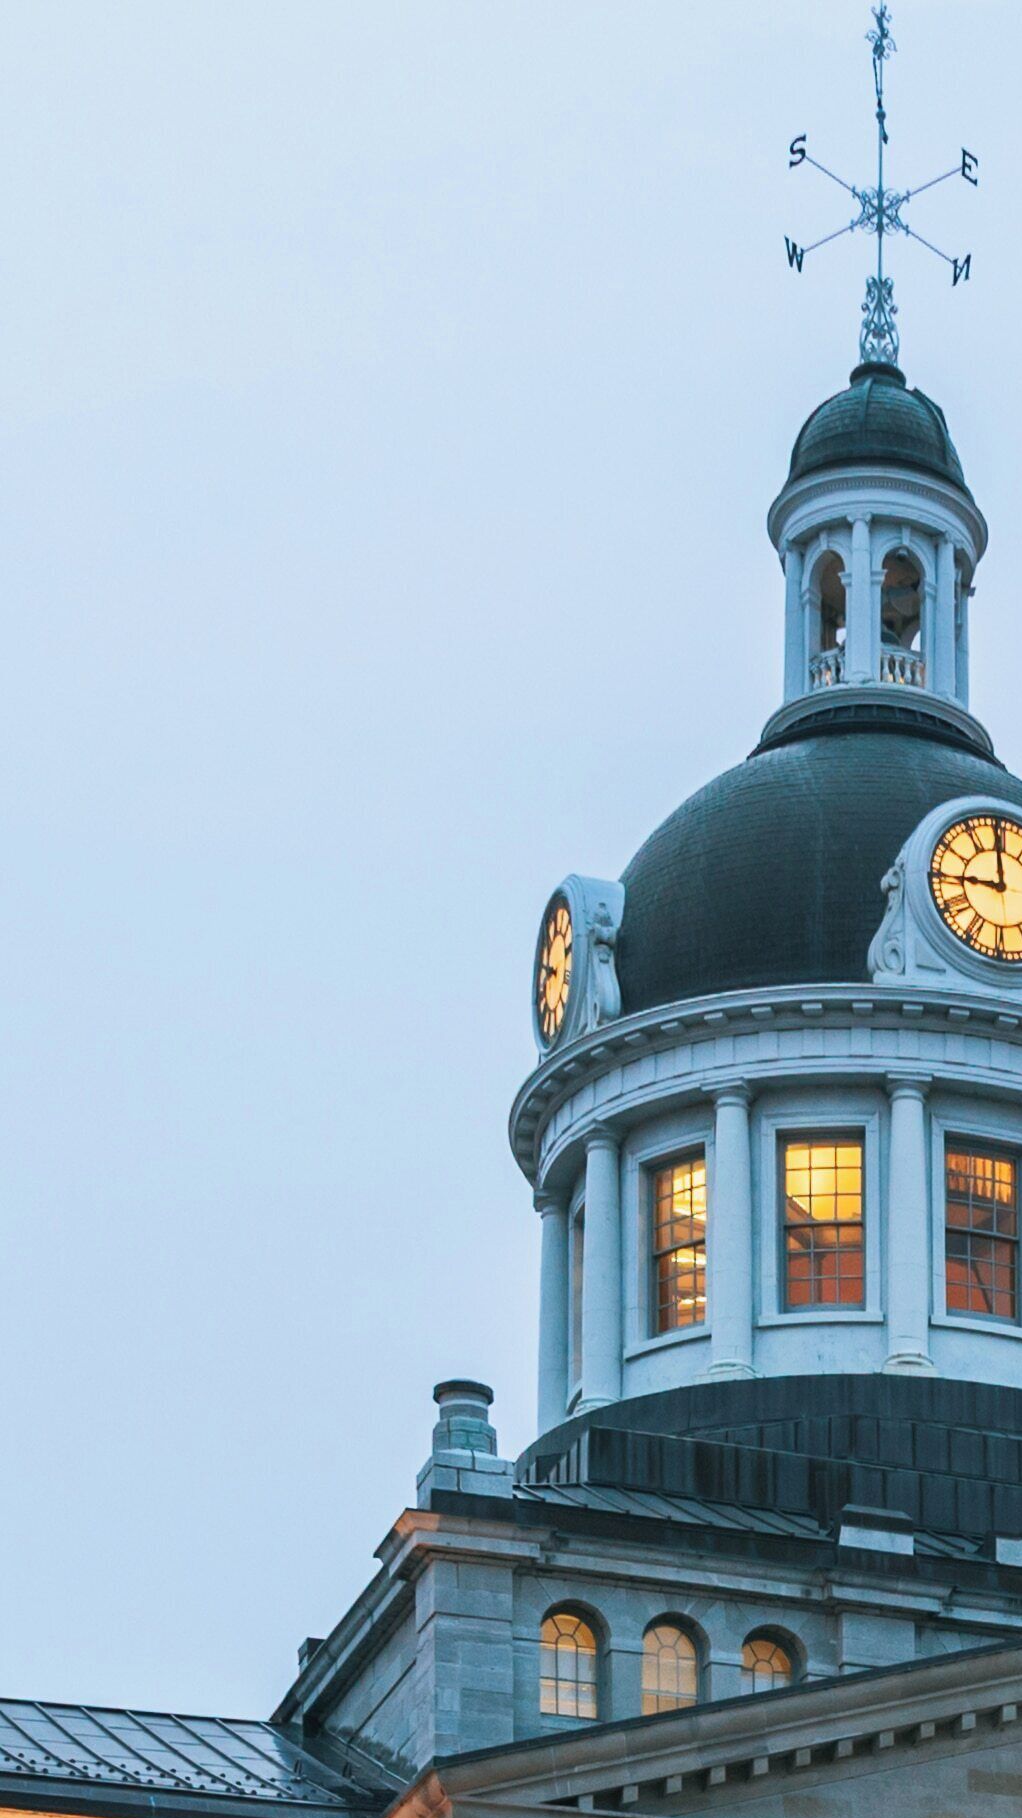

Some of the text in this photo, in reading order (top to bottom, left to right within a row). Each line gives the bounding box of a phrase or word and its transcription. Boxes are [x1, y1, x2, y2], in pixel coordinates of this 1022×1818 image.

[789, 133, 806, 168] S
[961, 147, 978, 186] E
[784, 235, 804, 273] W
